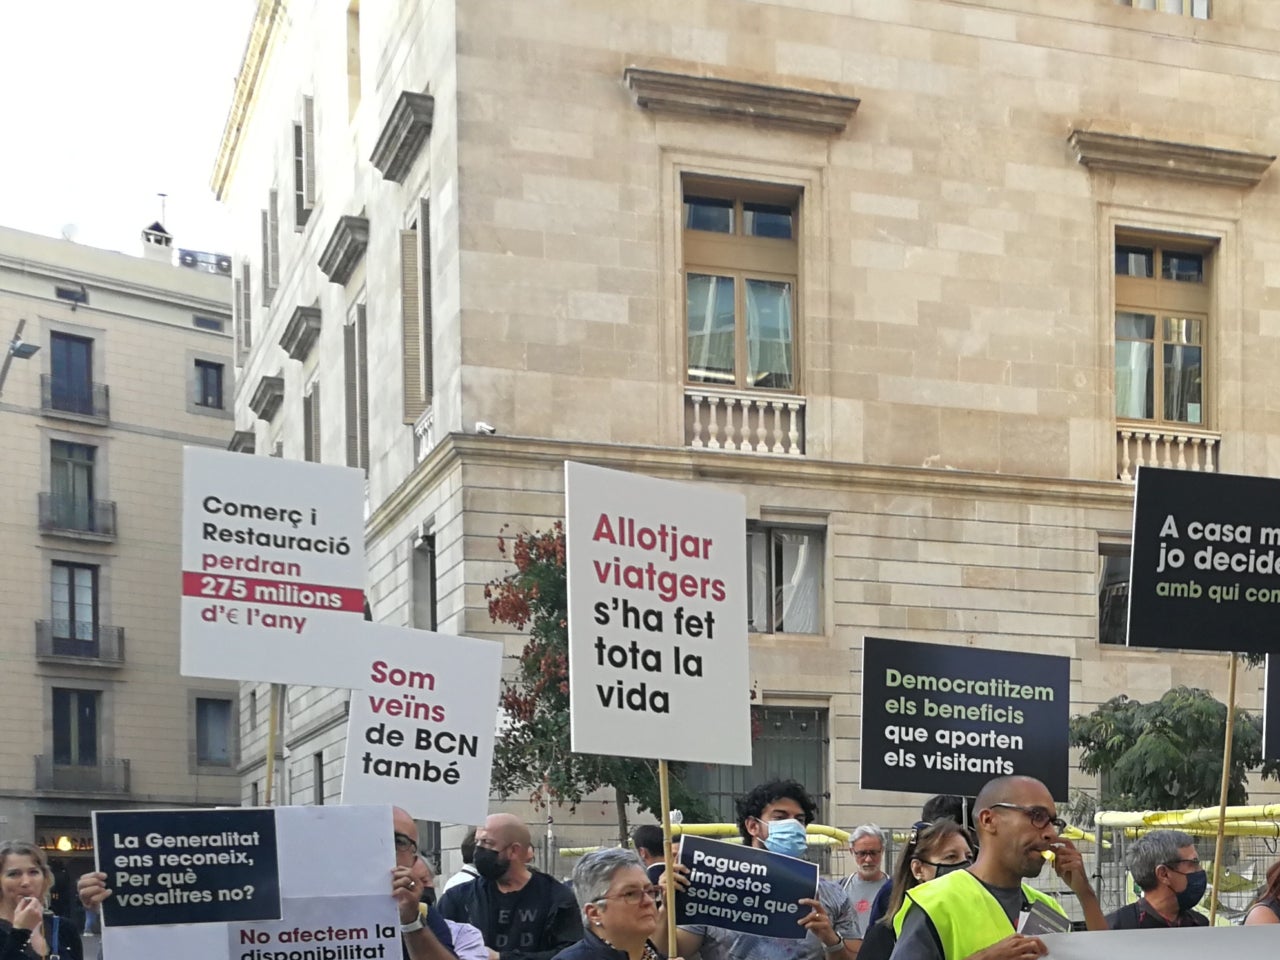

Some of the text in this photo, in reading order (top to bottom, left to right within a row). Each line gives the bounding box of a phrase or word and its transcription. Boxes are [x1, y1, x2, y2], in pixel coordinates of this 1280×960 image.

[202, 496, 317, 526] Comerç i
[202, 524, 350, 556] Restauració
[592, 513, 713, 562] Allotjar
[1159, 515, 1179, 539] A
[1187, 522, 1252, 544] casa
[202, 552, 301, 577] perdran
[1156, 543, 1185, 573] jo
[201, 577, 342, 608] 275 milions
[593, 556, 726, 603] viatgers
[1155, 579, 1202, 600] amb
[1208, 583, 1239, 604] qui
[673, 605, 715, 640] fet
[595, 637, 703, 677] tota la
[370, 661, 436, 691] Som
[885, 669, 1054, 702] Democratitzem
[369, 693, 446, 722] veïns
[596, 681, 671, 714] vida
[885, 697, 1024, 725] els beneficis
[365, 723, 479, 757] de BCN
[884, 725, 1023, 752] que aporten
[362, 753, 461, 785] també
[884, 749, 1014, 775] els visitants
[114, 832, 260, 849] La Generalitat
[115, 850, 254, 868] ens reconeix,
[693, 850, 768, 877] Paguem
[116, 868, 197, 888] Per què
[689, 868, 771, 894] impostos
[117, 885, 255, 907] vosaltres no?
[687, 886, 798, 917] sobre el que
[685, 902, 769, 926] guanyem
[240, 923, 396, 945] No afectem la
